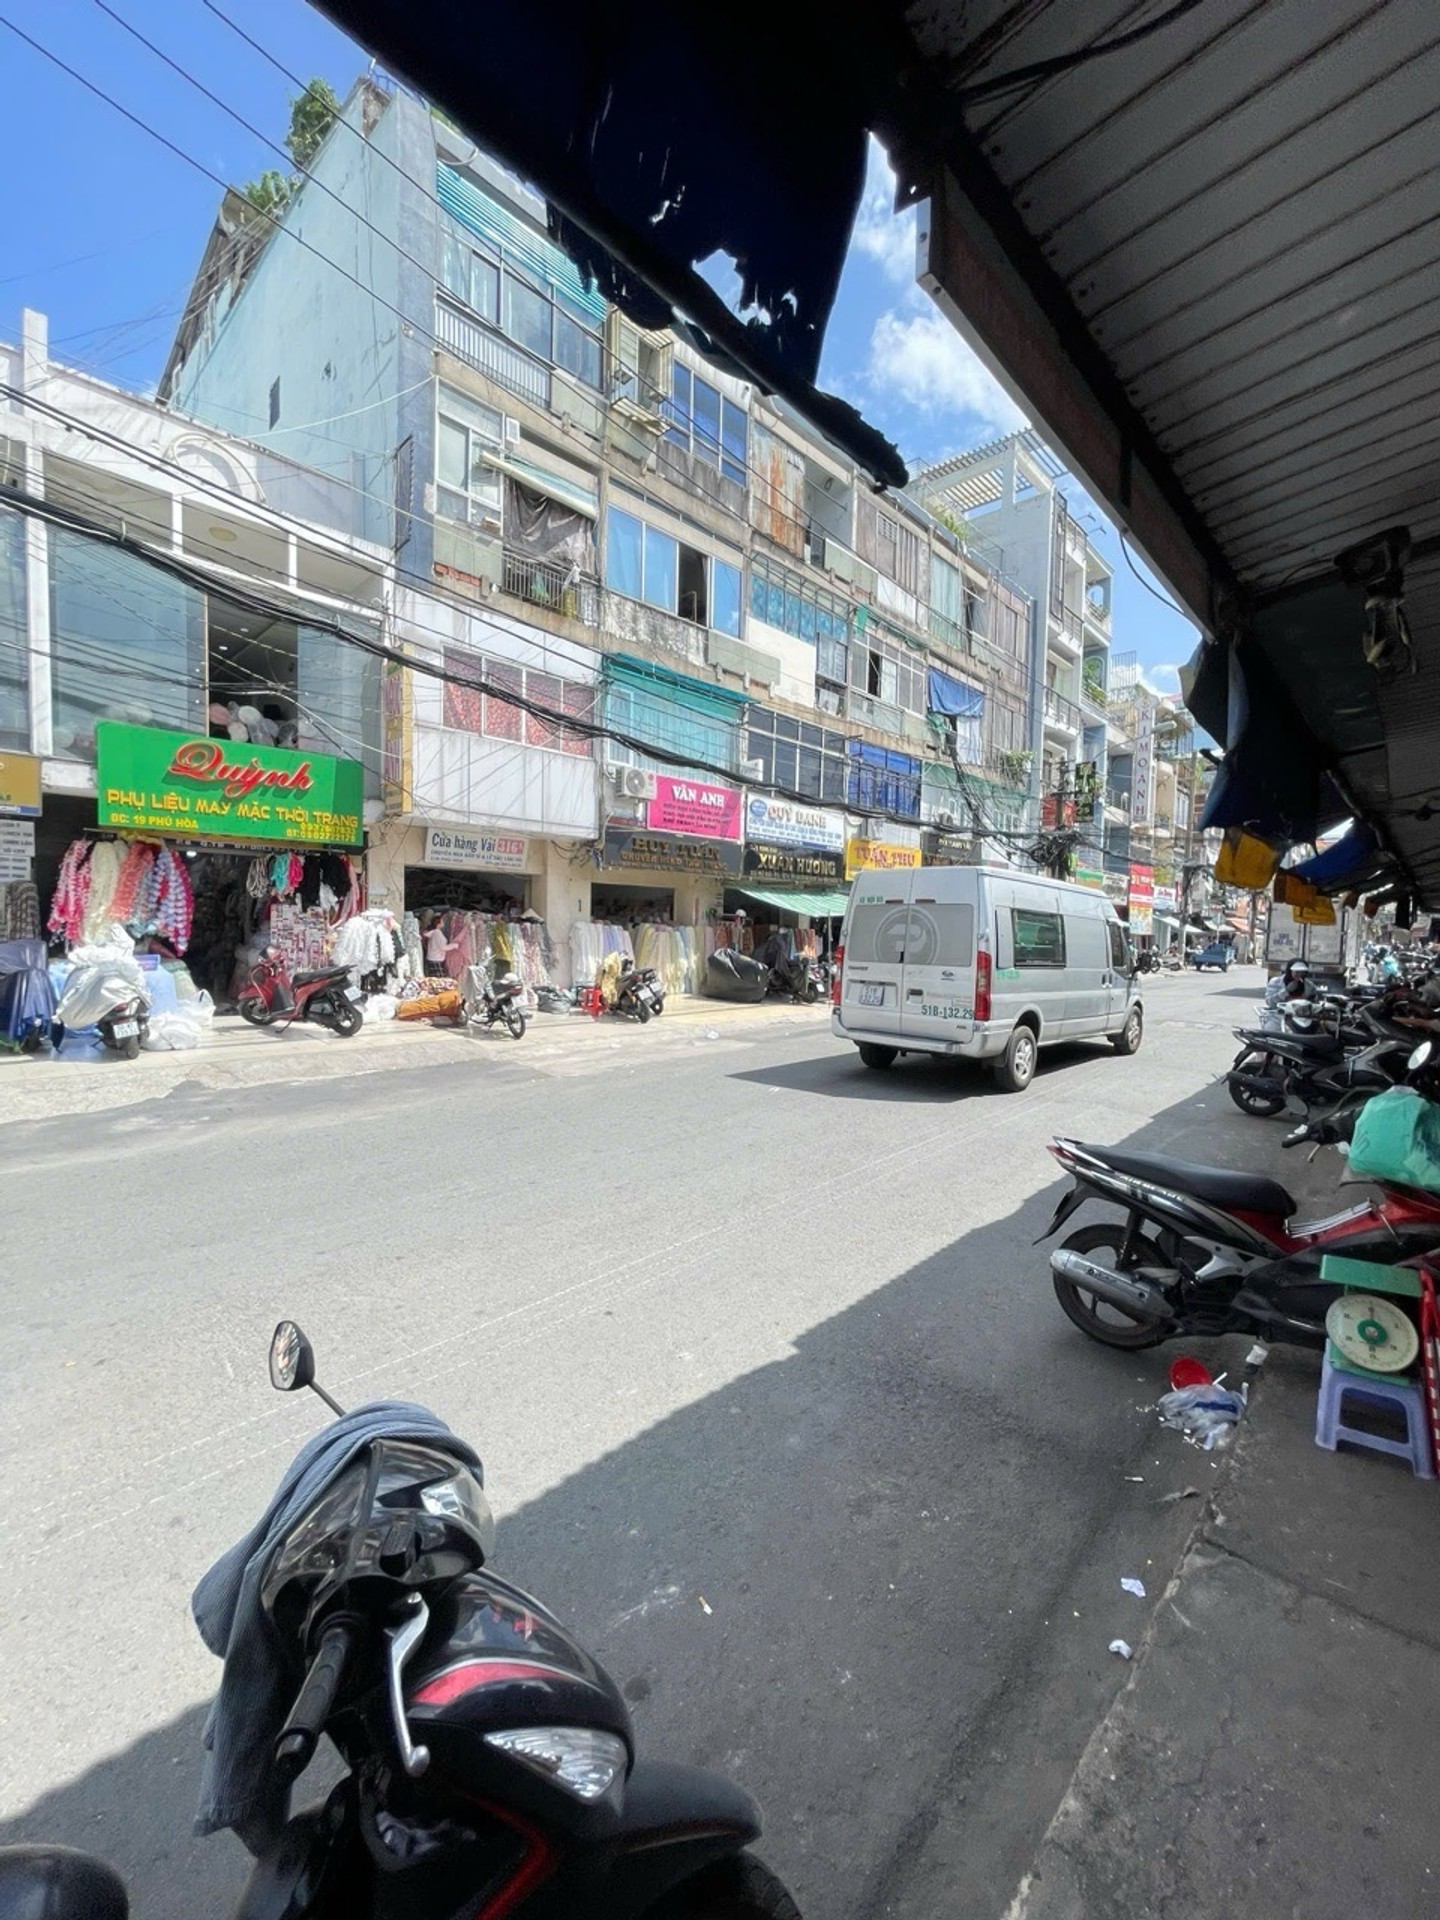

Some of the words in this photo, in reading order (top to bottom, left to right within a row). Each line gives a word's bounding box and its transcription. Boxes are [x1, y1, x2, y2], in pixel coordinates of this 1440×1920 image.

[168, 740, 314, 798] Quỳnh
[672, 784, 697, 802] VÂN
[700, 791, 725, 807] ANH
[107, 789, 145, 812] PHỤ
[151, 792, 190, 814] LIỆU
[195, 798, 232, 815] MAY
[237, 801, 270, 821] MẶC
[276, 806, 309, 823] THỜI
[313, 811, 359, 828] TRANG
[148, 815, 173, 827] PHÚ
[175, 817, 199, 830] HÒA
[431, 832, 451, 848] Cửa
[454, 835, 478, 853] hàng
[481, 837, 496, 852] Vải
